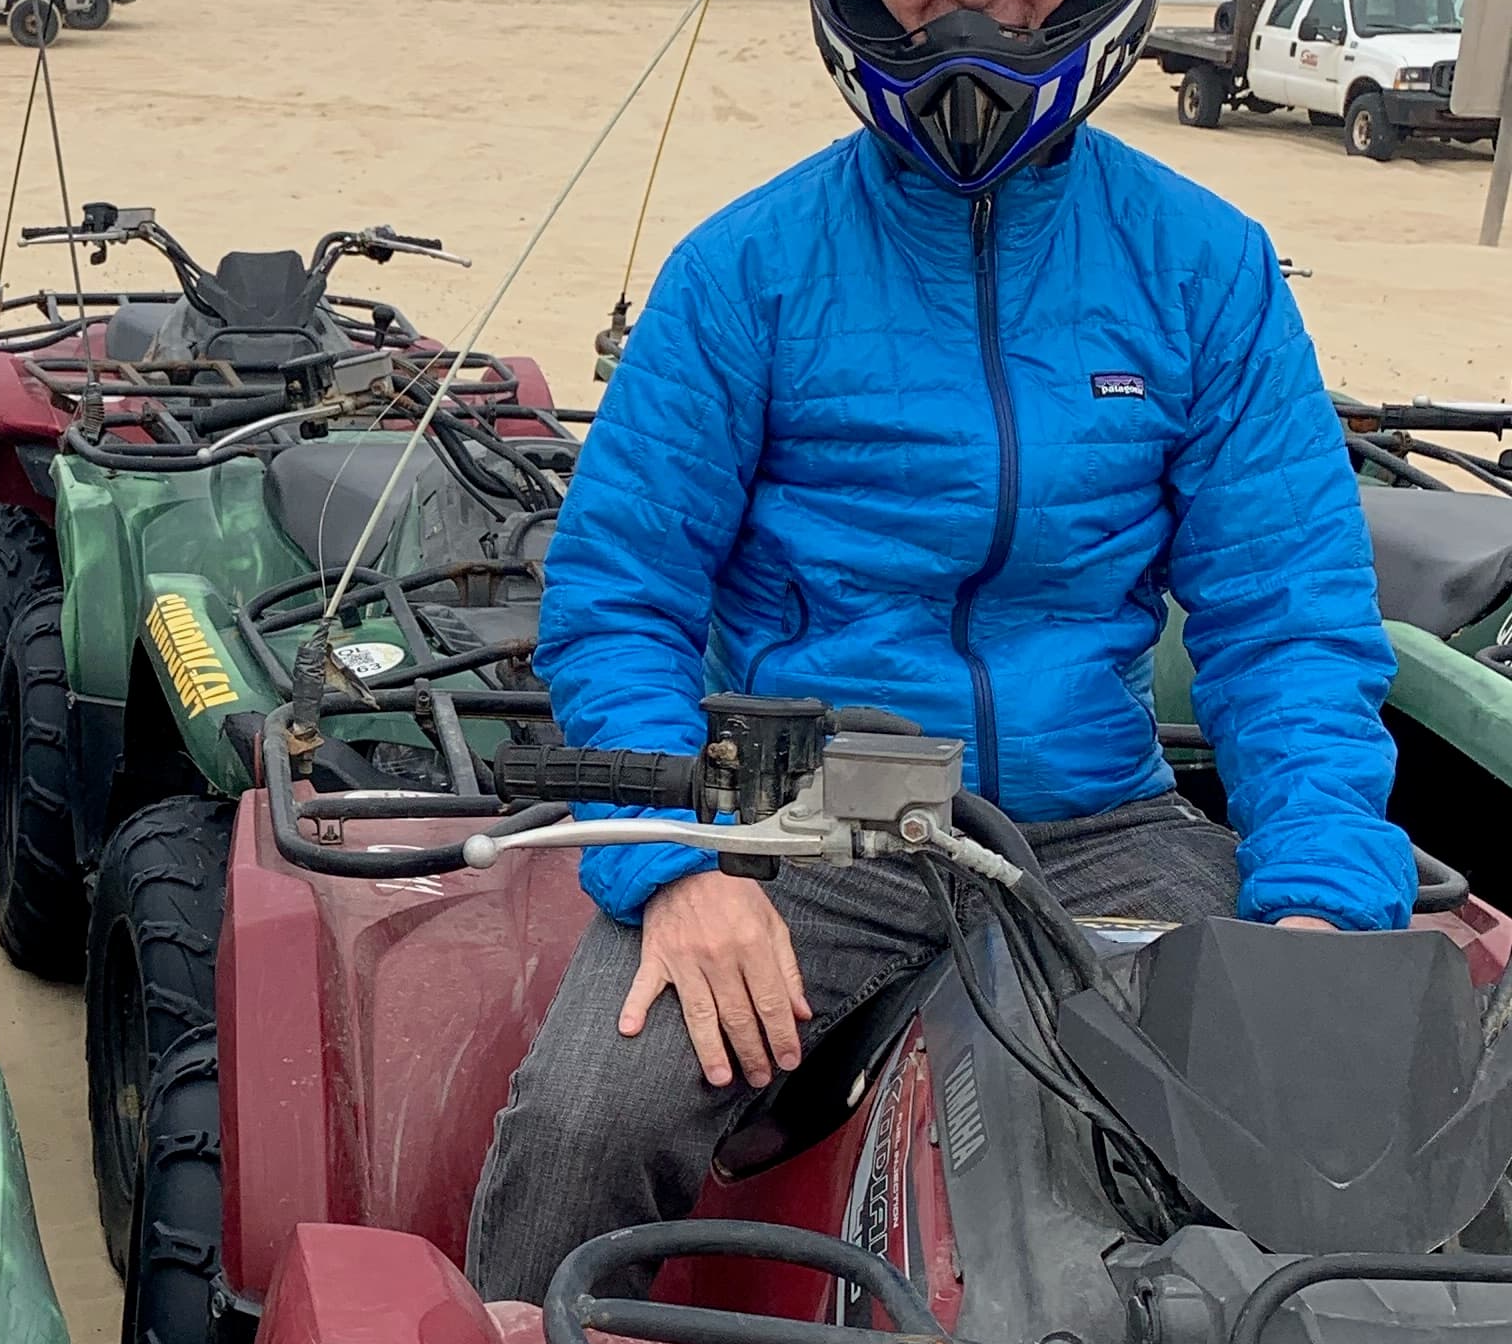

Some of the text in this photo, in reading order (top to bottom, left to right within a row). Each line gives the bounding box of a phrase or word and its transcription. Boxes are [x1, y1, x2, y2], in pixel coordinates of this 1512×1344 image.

[945, 1051, 986, 1170] YAMAHA
[892, 1112, 904, 1229] FUEL INJECTION
